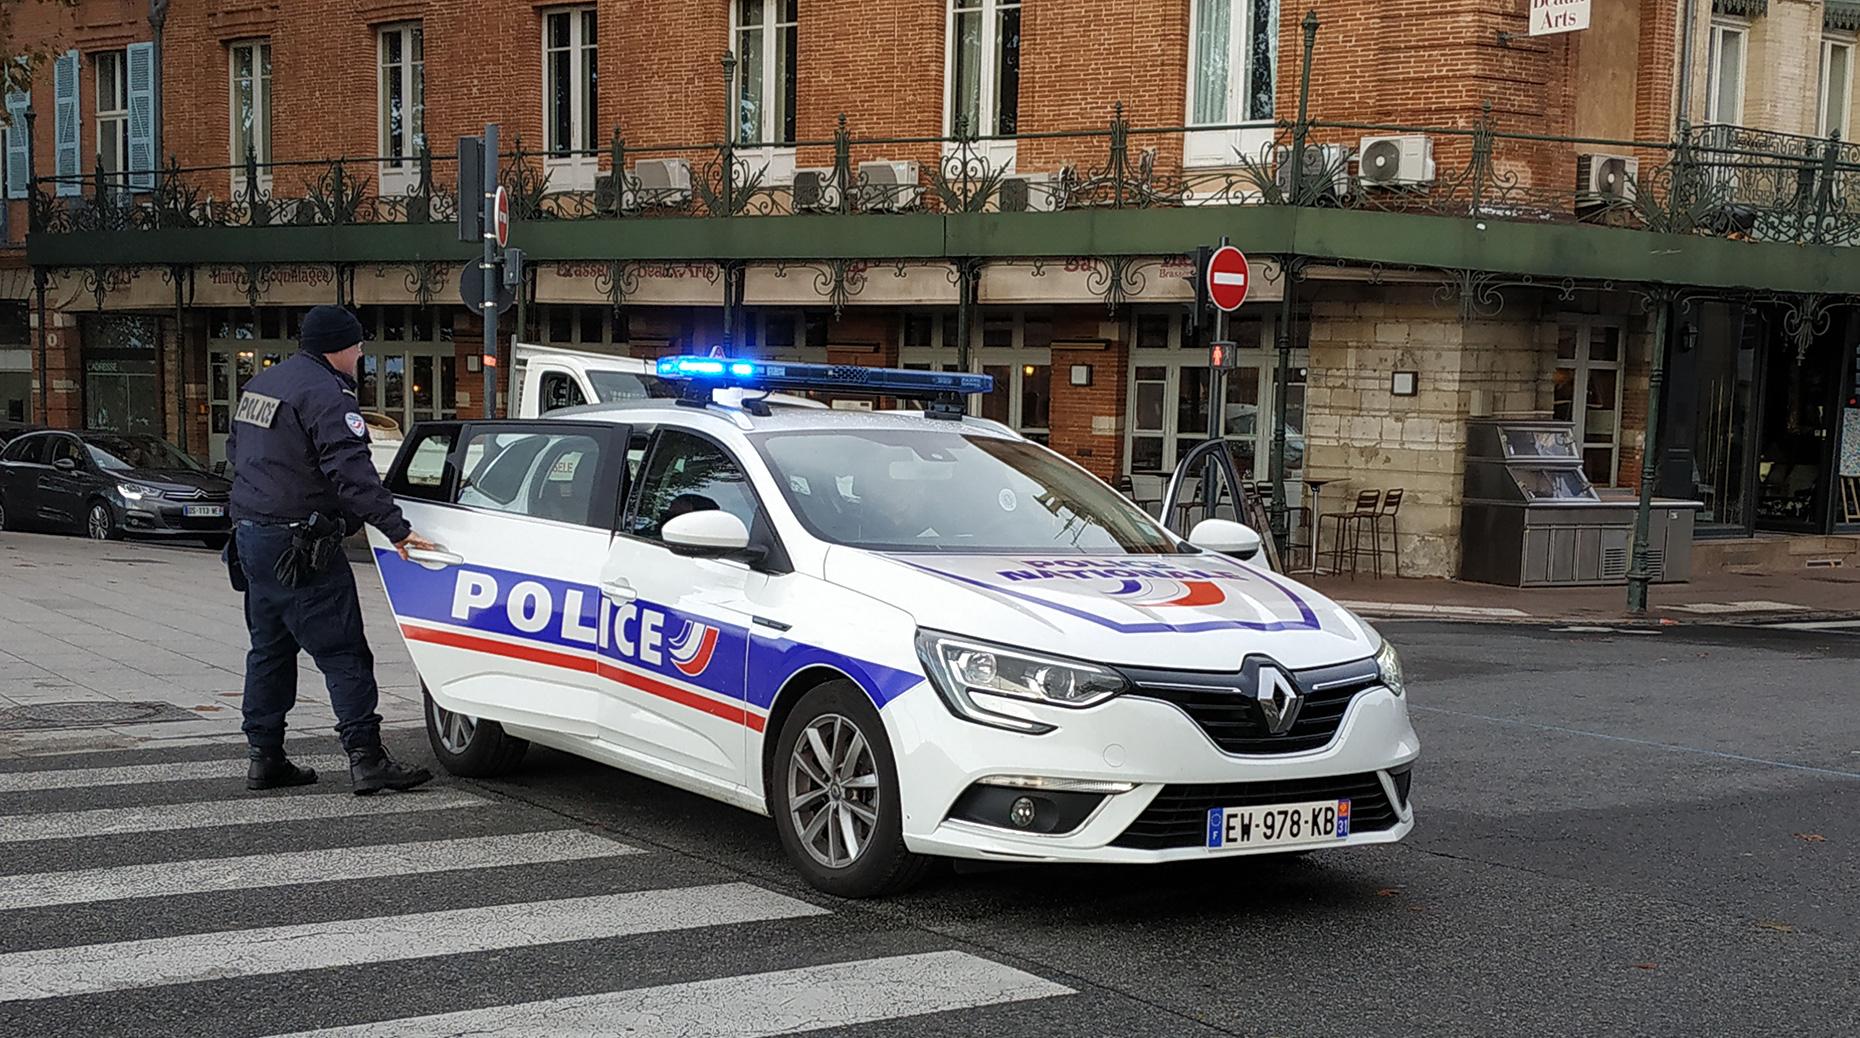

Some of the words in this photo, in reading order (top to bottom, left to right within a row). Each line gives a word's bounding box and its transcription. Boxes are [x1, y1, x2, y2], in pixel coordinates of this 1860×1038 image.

[1541, 10, 1576, 30] Arts
[238, 396, 276, 424] POLICE
[1021, 559, 1176, 569] POLICE
[996, 569, 1250, 581] NATIONALE
[451, 569, 663, 666] POLICE
[1224, 806, 1335, 843] EW-978-KB
[1338, 819, 1348, 833] 31
[1212, 831, 1219, 840] F
